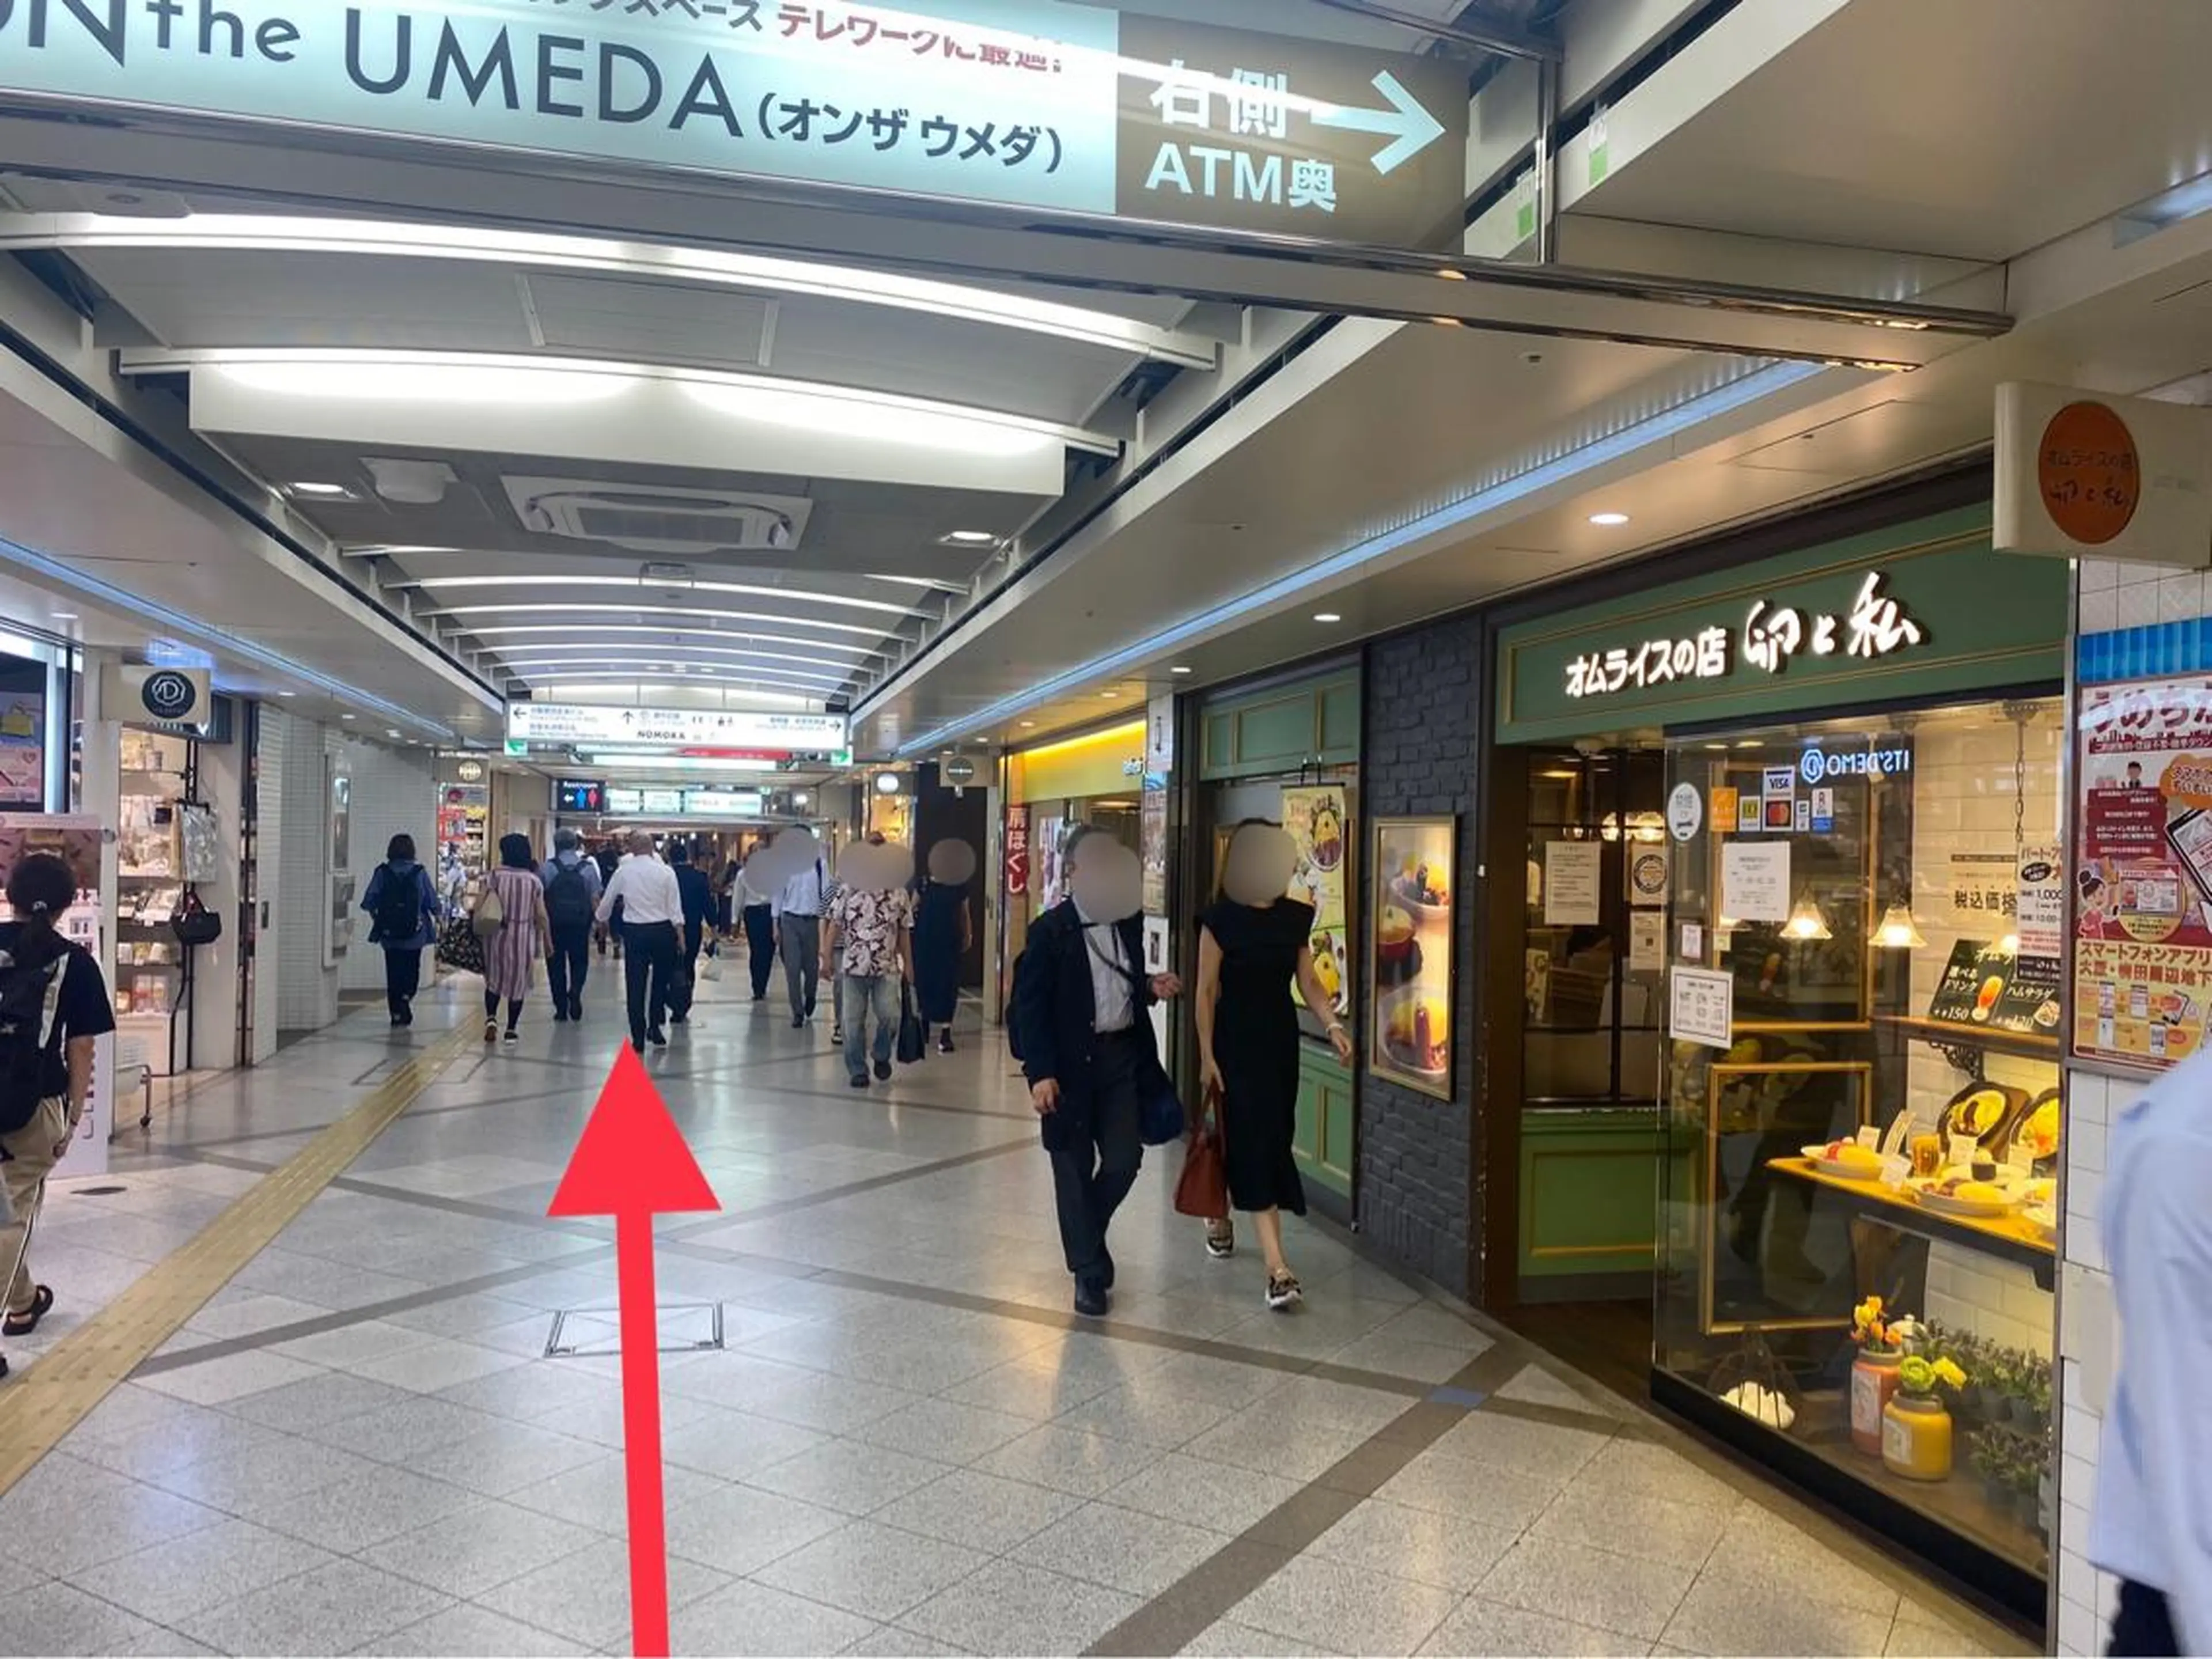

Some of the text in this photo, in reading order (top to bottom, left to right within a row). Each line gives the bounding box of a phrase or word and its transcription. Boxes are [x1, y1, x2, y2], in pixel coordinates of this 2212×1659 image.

[346, 8, 744, 138] UMEDA
[1150, 60, 1288, 139] 右側
[1145, 142, 1337, 214] ATM奥
[1565, 570, 1922, 698] オムライスの店 卵と私
[1769, 778, 1789, 789] VISA
